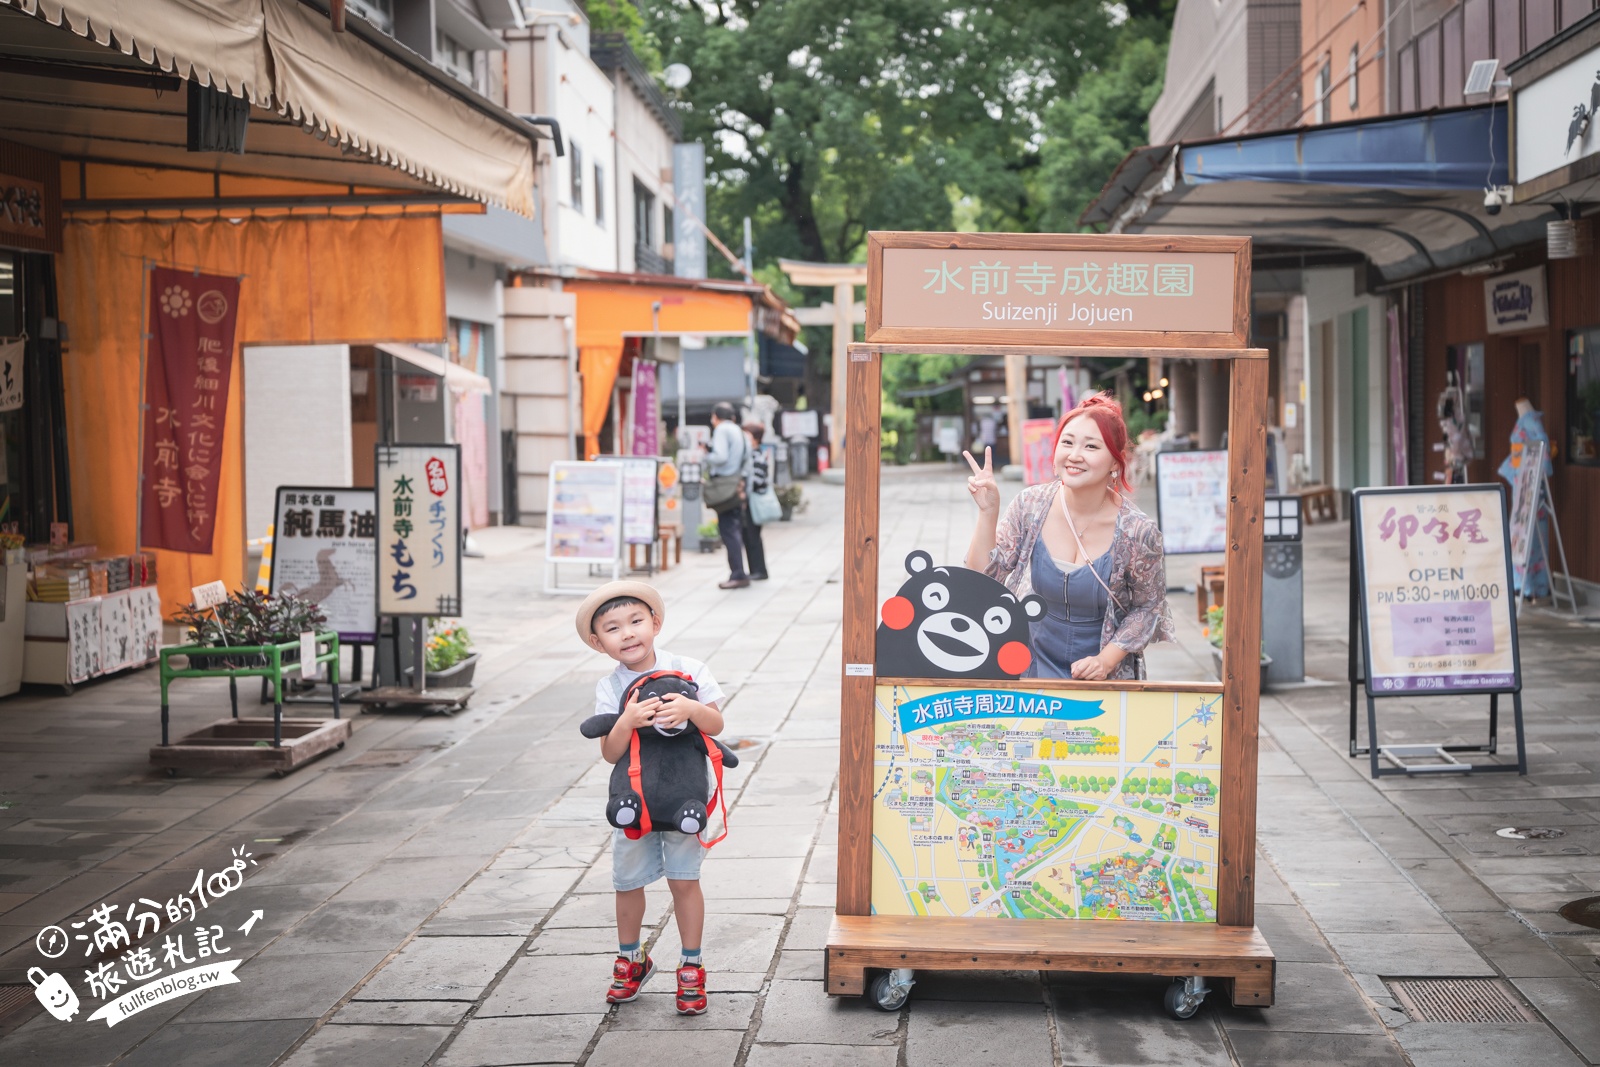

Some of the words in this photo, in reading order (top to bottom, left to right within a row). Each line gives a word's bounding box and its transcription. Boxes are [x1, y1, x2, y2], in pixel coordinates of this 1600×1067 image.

[922, 260, 1195, 297] 水前寺成趣園
[982, 301, 1058, 326] Suizenji
[1067, 302, 1133, 327] Jojuen
[152, 407, 182, 508] 水前寺
[285, 493, 336, 506] 熊本名産
[283, 508, 375, 539] 純馬油
[390, 474, 417, 601] 水前寺もち
[428, 500, 446, 569] 手づくり
[1408, 567, 1464, 582] OPEN
[1377, 591, 1394, 603] PM
[1396, 585, 1431, 603] 5:30
[1443, 589, 1460, 601] PM
[1460, 583, 1500, 600] 10:00
[911, 693, 1016, 724] 水前寺周辺
[1018, 697, 1063, 716] MAP
